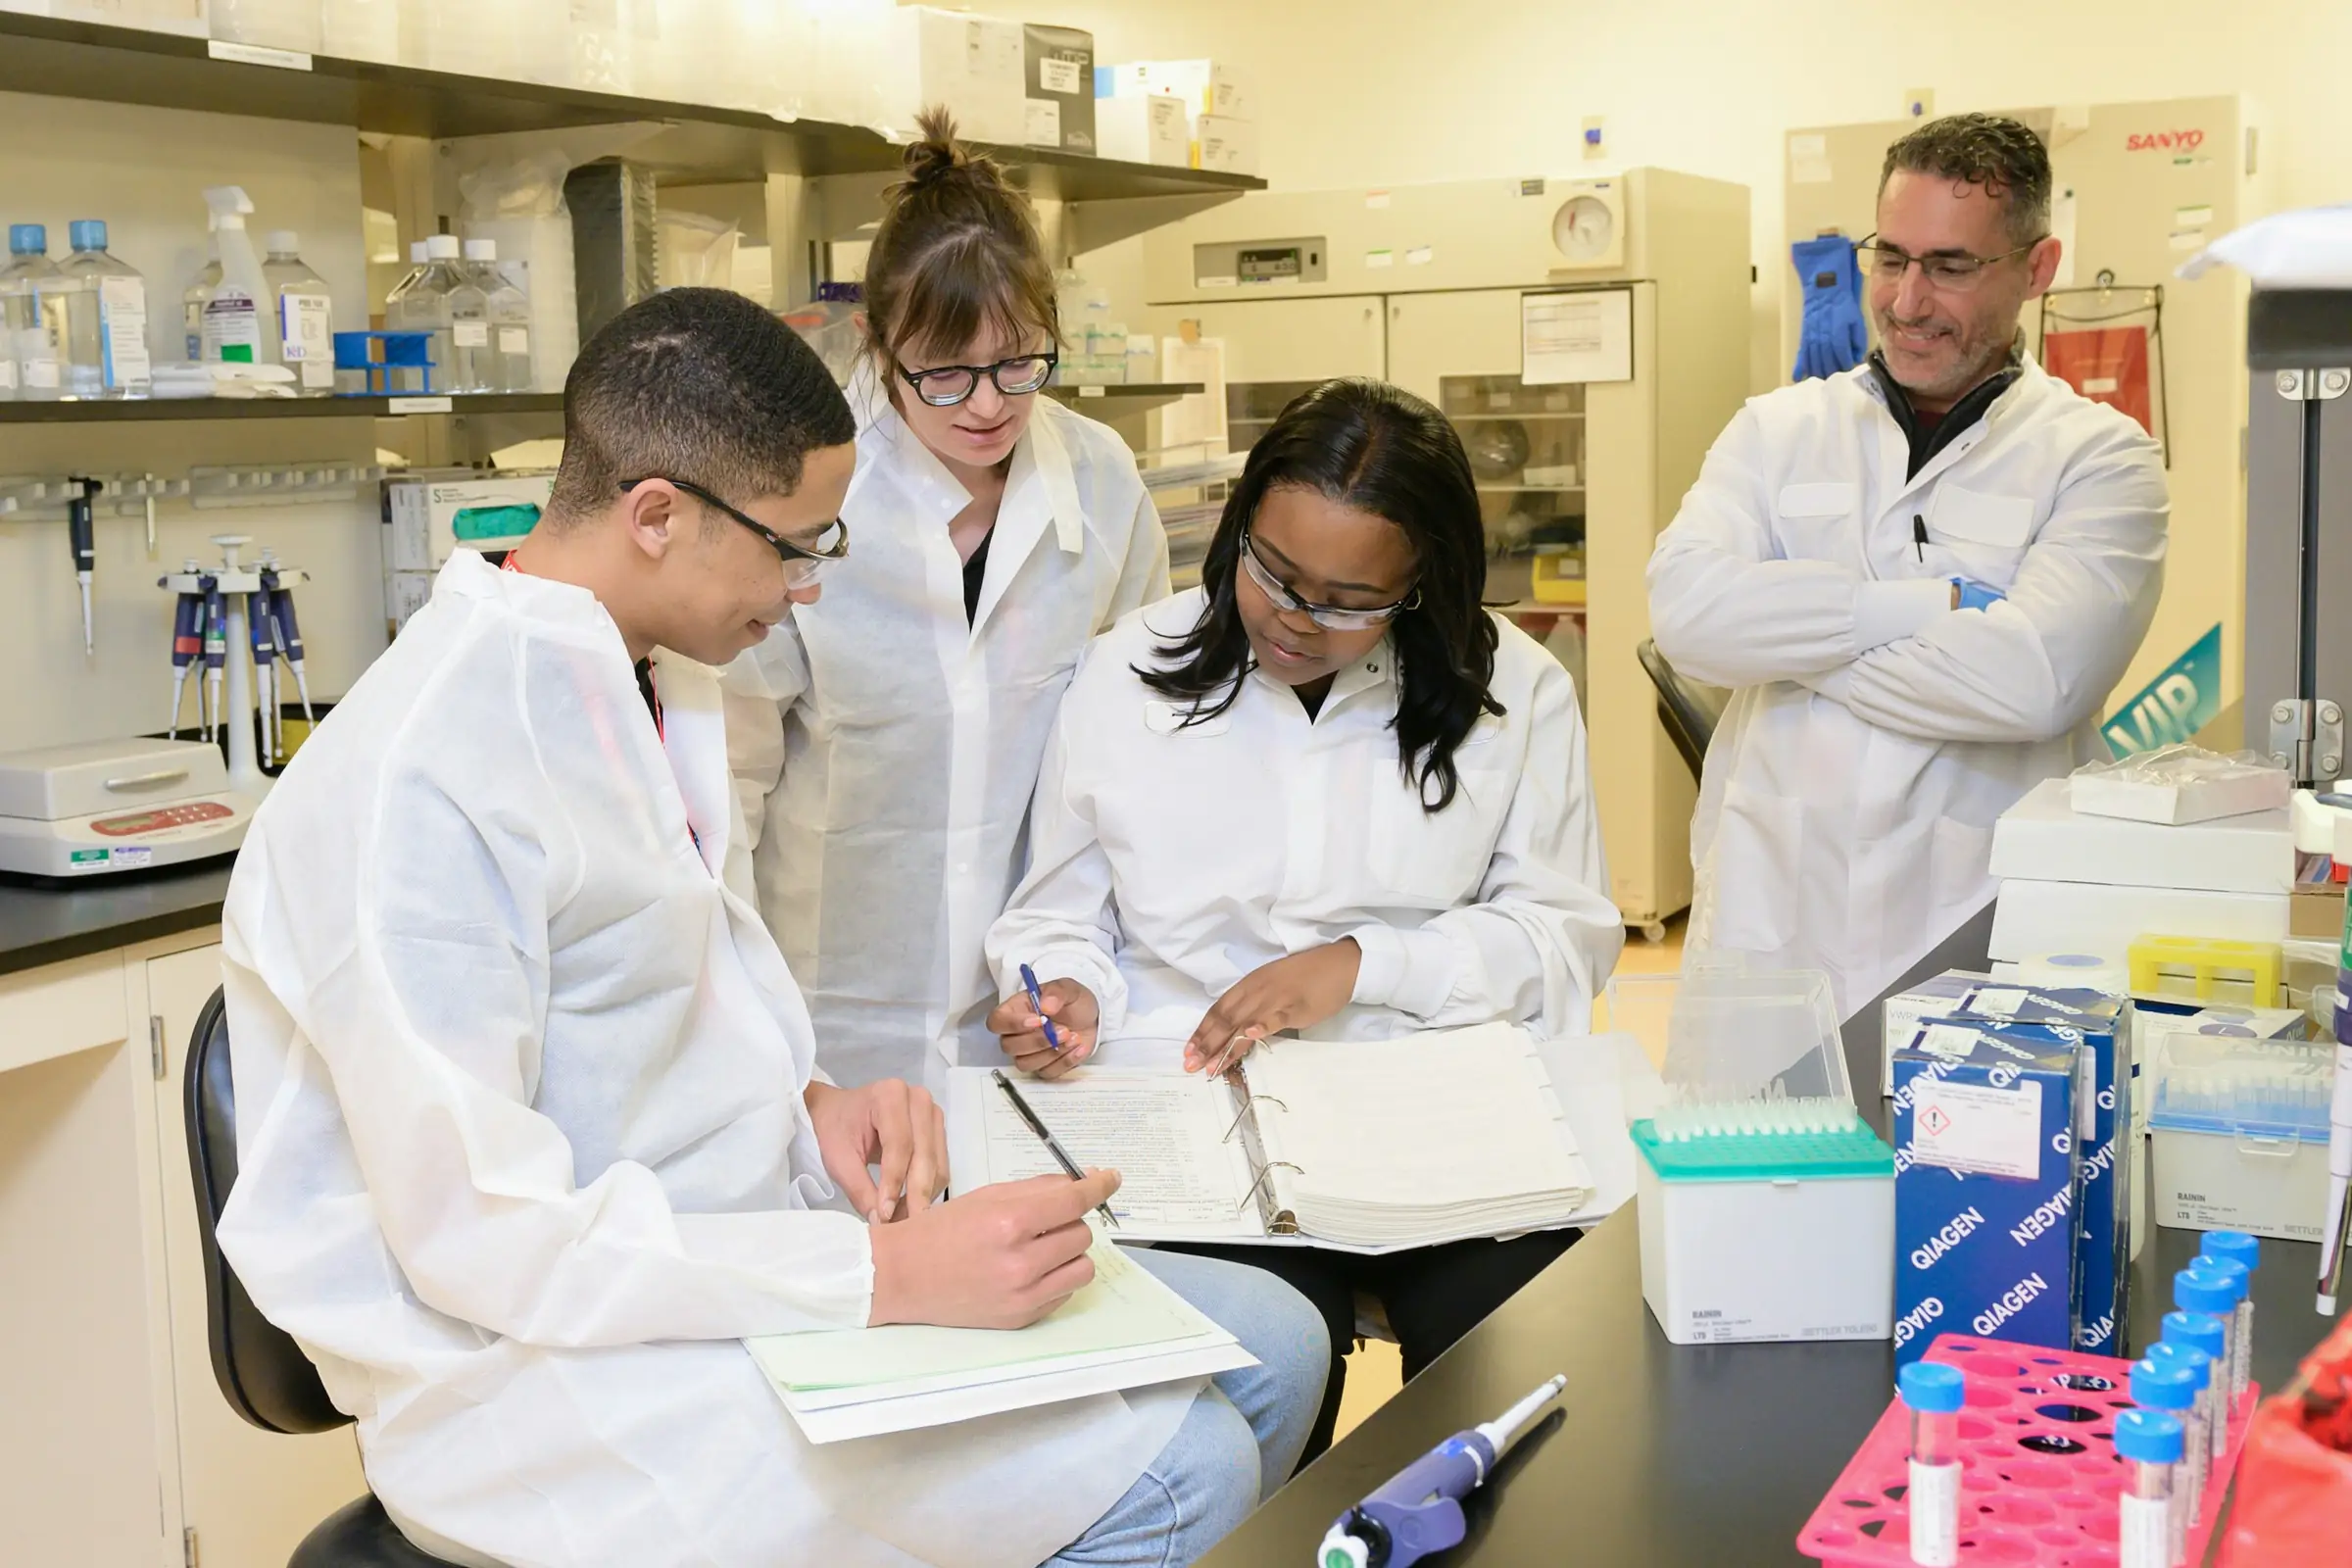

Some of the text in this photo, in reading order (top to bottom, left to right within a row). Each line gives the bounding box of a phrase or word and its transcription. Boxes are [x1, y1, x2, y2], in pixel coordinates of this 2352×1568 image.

[2126, 128, 2204, 152] SANYO
[2106, 672, 2199, 753] VIP
[2178, 1193, 2206, 1202] RAININ
[1911, 1205, 1985, 1271] QIAGEN
[1692, 1309, 1722, 1319] RAININ
[1973, 1271, 2048, 1337] QIAGEN
[1844, 1324, 1878, 1335] TOLEDO
